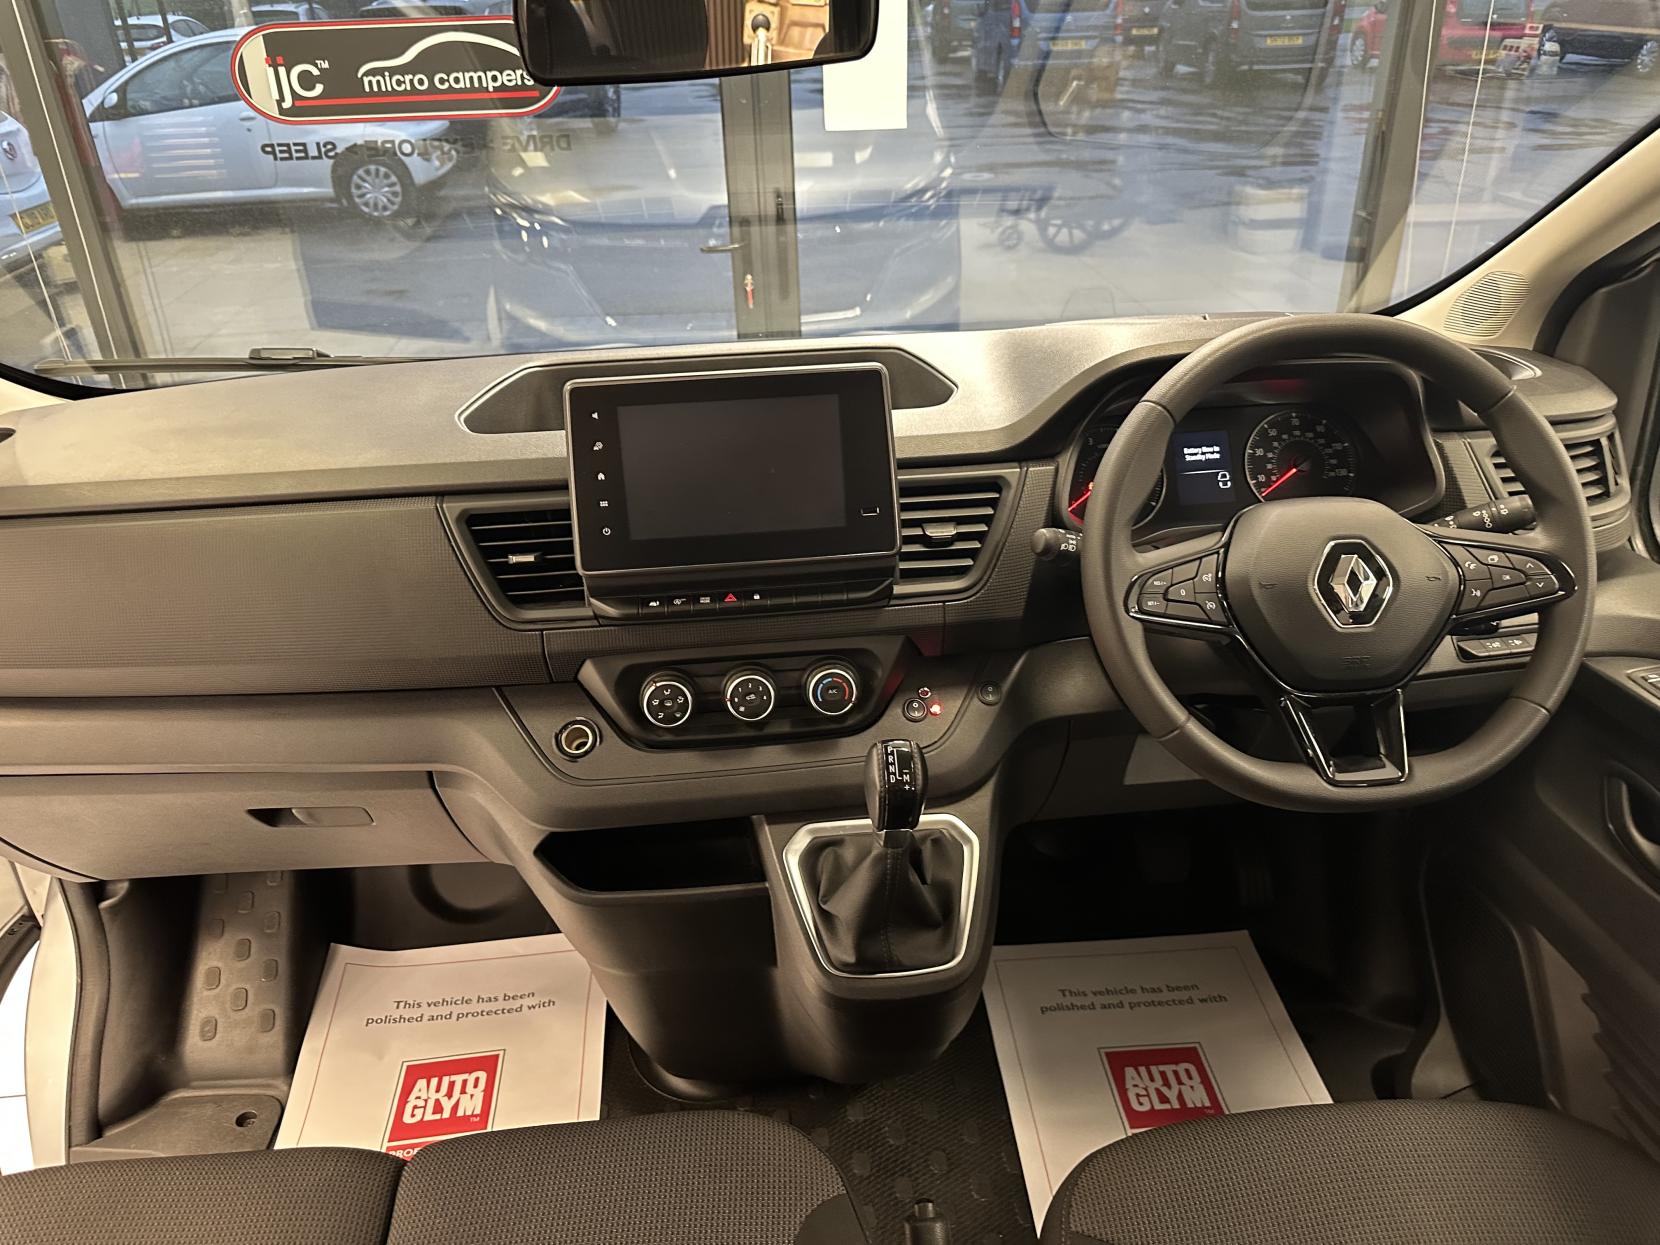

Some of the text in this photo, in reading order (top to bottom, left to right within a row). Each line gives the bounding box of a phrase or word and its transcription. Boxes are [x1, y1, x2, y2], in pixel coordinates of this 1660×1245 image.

[362, 69, 535, 92] micro campers
[887, 746, 893, 754] P
[888, 755, 894, 763] R
[889, 765, 895, 773] N
[890, 775, 896, 783] D
[903, 774, 910, 782] M
[1058, 982, 1200, 998] This vehicle has been
[393, 991, 536, 1010] This vehicle has been
[1040, 993, 1228, 1015] polished and protected with
[365, 999, 556, 1027] polished and protected with
[1124, 1062, 1201, 1088] AUTO
[407, 1071, 488, 1101] AUTO
[402, 1091, 484, 1124] GLYM
[1127, 1083, 1211, 1112] GLYM
